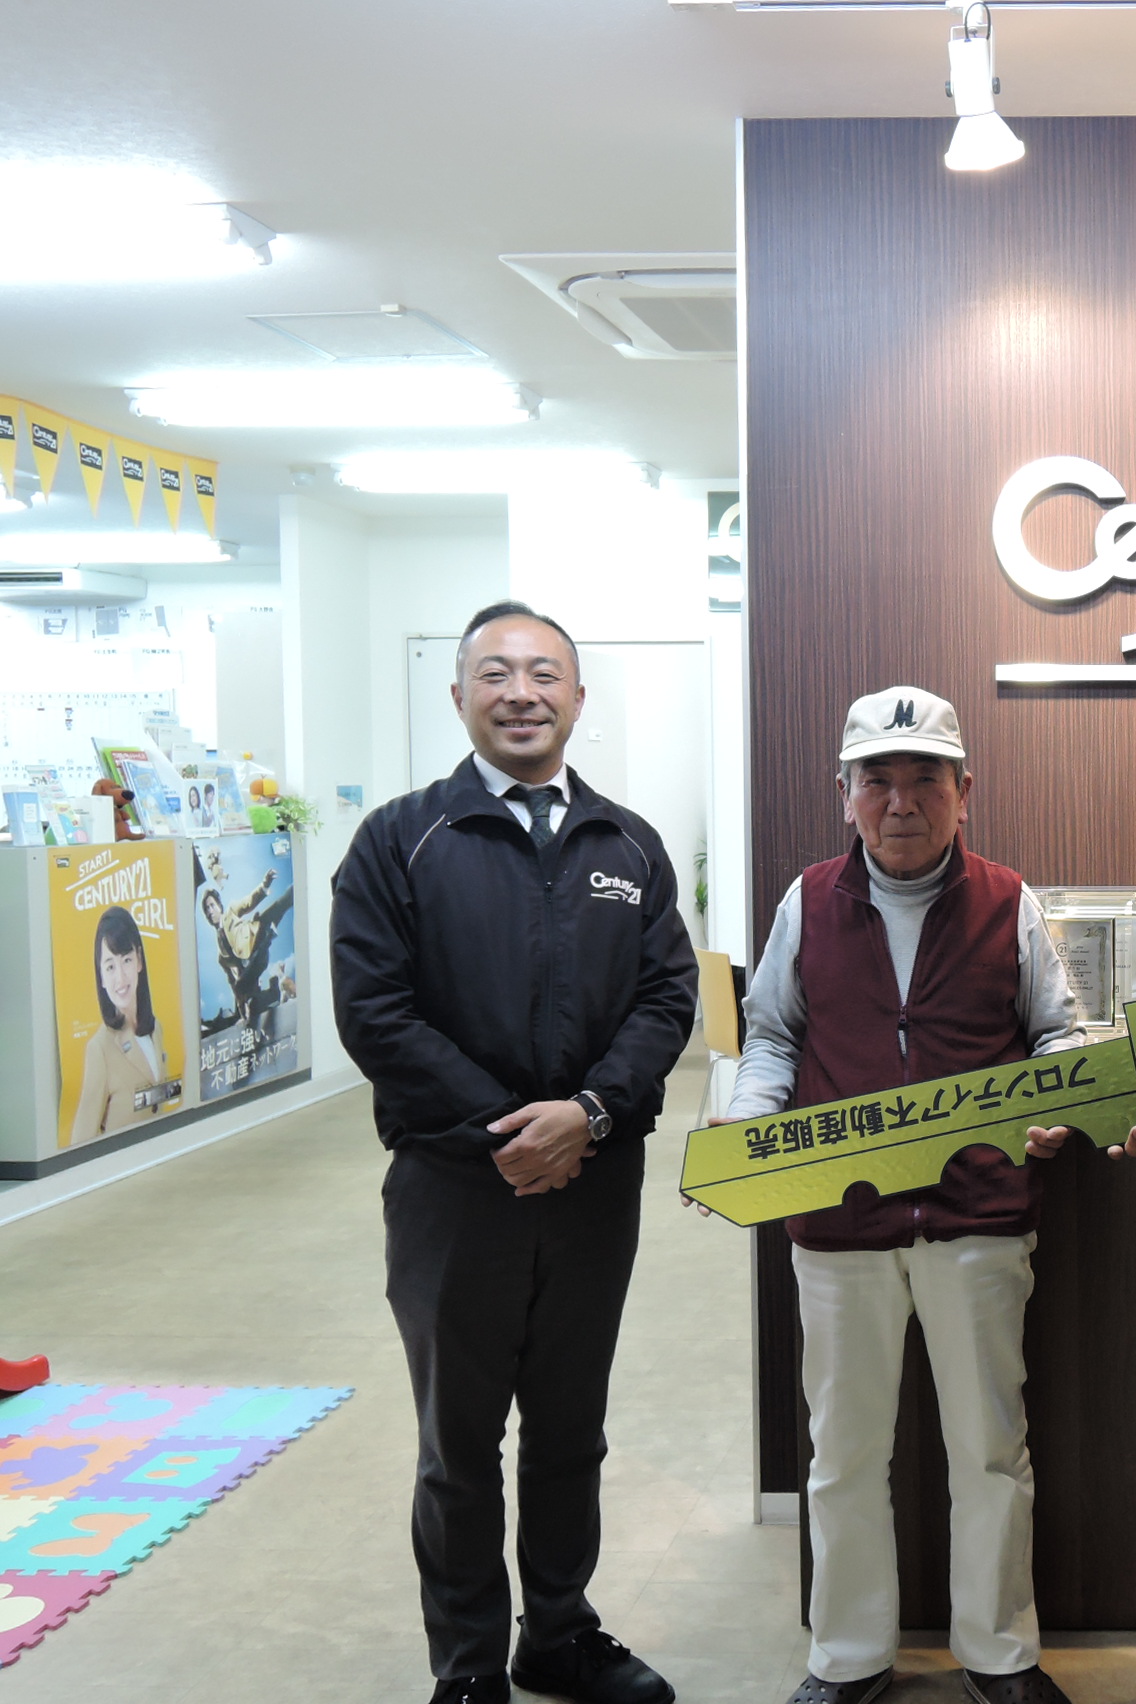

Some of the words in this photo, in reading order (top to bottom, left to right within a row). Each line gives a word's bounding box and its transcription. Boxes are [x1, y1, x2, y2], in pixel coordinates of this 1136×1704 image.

[883, 699, 917, 730] M
[79, 849, 112, 878] START!
[590, 871, 635, 893] Century
[627, 888, 642, 905] 21
[131, 898, 174, 930] GIRL
[201, 1028, 270, 1072] 地元に強い、
[211, 1034, 297, 1091] 不動産ネットワーク
[744, 1057, 1096, 1161] フロンティア不動産販売
